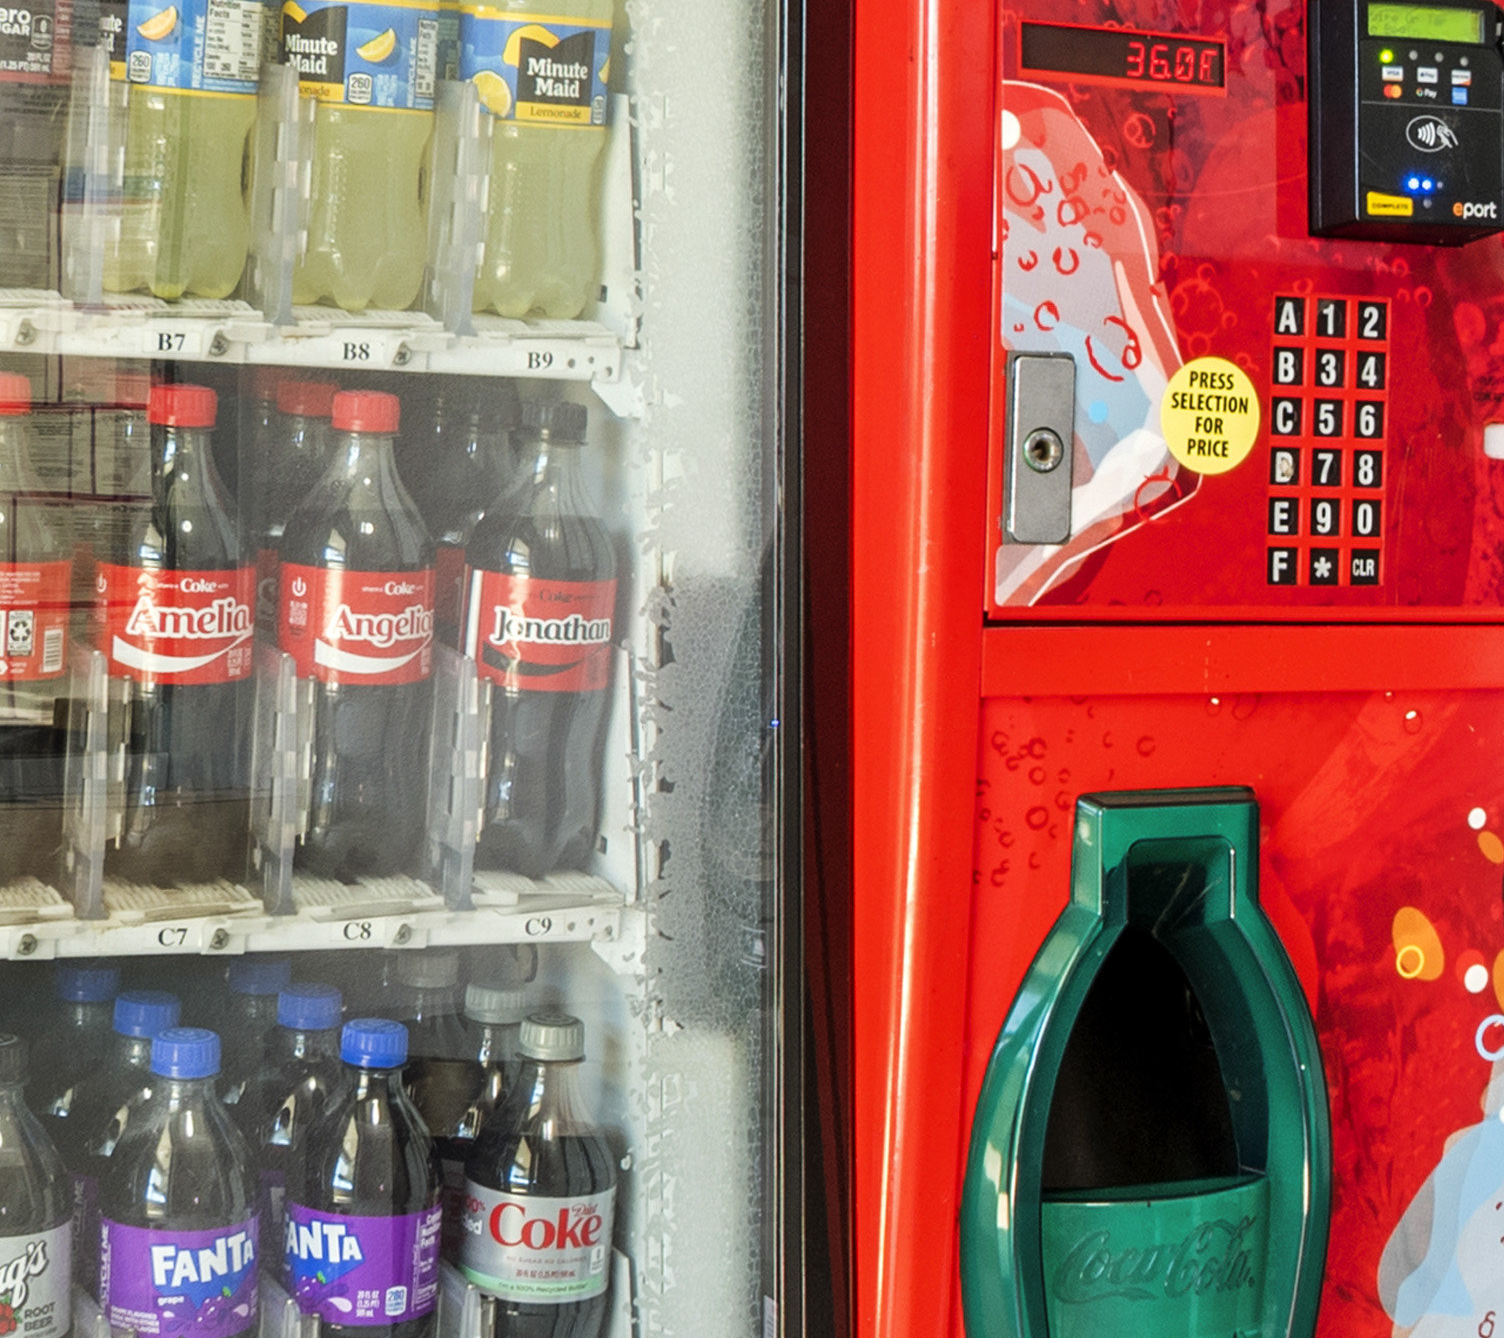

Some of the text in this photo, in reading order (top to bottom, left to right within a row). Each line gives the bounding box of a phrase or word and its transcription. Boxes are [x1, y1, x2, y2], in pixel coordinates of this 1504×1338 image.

[525, 56, 589, 81] Minute
[534, 75, 582, 99] Maid
[529, 105, 583, 120] Lemonade
[1452, 201, 1496, 220] eport
[1279, 305, 1298, 332] A
[1322, 307, 1336, 335] 1
[1362, 307, 1379, 336] 2
[526, 350, 554, 370] B9
[1279, 355, 1295, 382] B
[1320, 357, 1336, 385] 3
[1188, 370, 1235, 391] PRESS
[1171, 392, 1249, 414] SELECTION
[1195, 415, 1223, 436] FOR
[1276, 405, 1293, 432] C
[1186, 436, 1229, 458] PRICE
[1358, 455, 1374, 485] 8
[1274, 504, 1289, 532] E
[1352, 558, 1375, 577] CLR
[126, 596, 253, 638] Amelia
[492, 601, 612, 643] Jonathan
[524, 916, 553, 936] C9
[488, 1201, 603, 1252] Coke
[150, 1230, 255, 1288] FANTA
